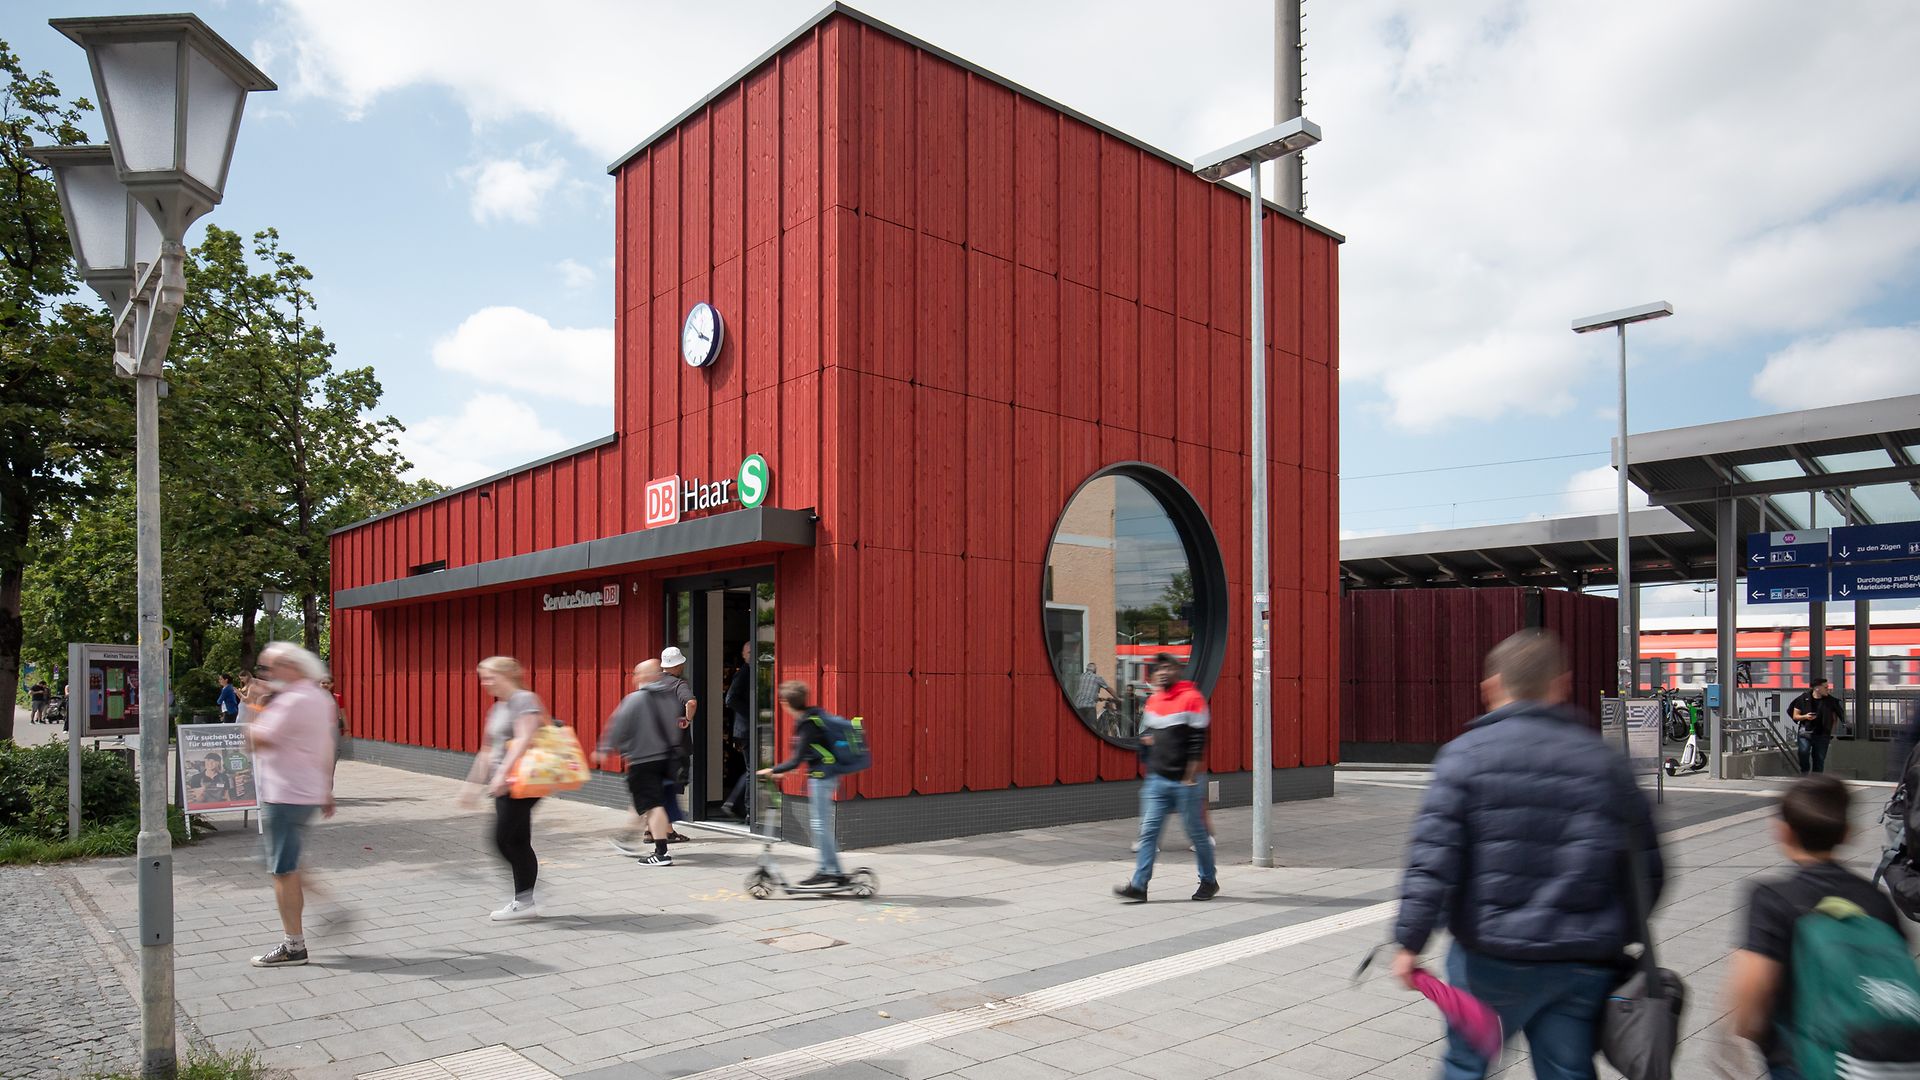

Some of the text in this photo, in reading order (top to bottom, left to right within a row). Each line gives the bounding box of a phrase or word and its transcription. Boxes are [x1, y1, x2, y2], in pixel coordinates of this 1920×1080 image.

[647, 458, 764, 523] DB Haar S
[543, 586, 617, 611] ServiceStore DB
[201, 733, 228, 741] suchen
